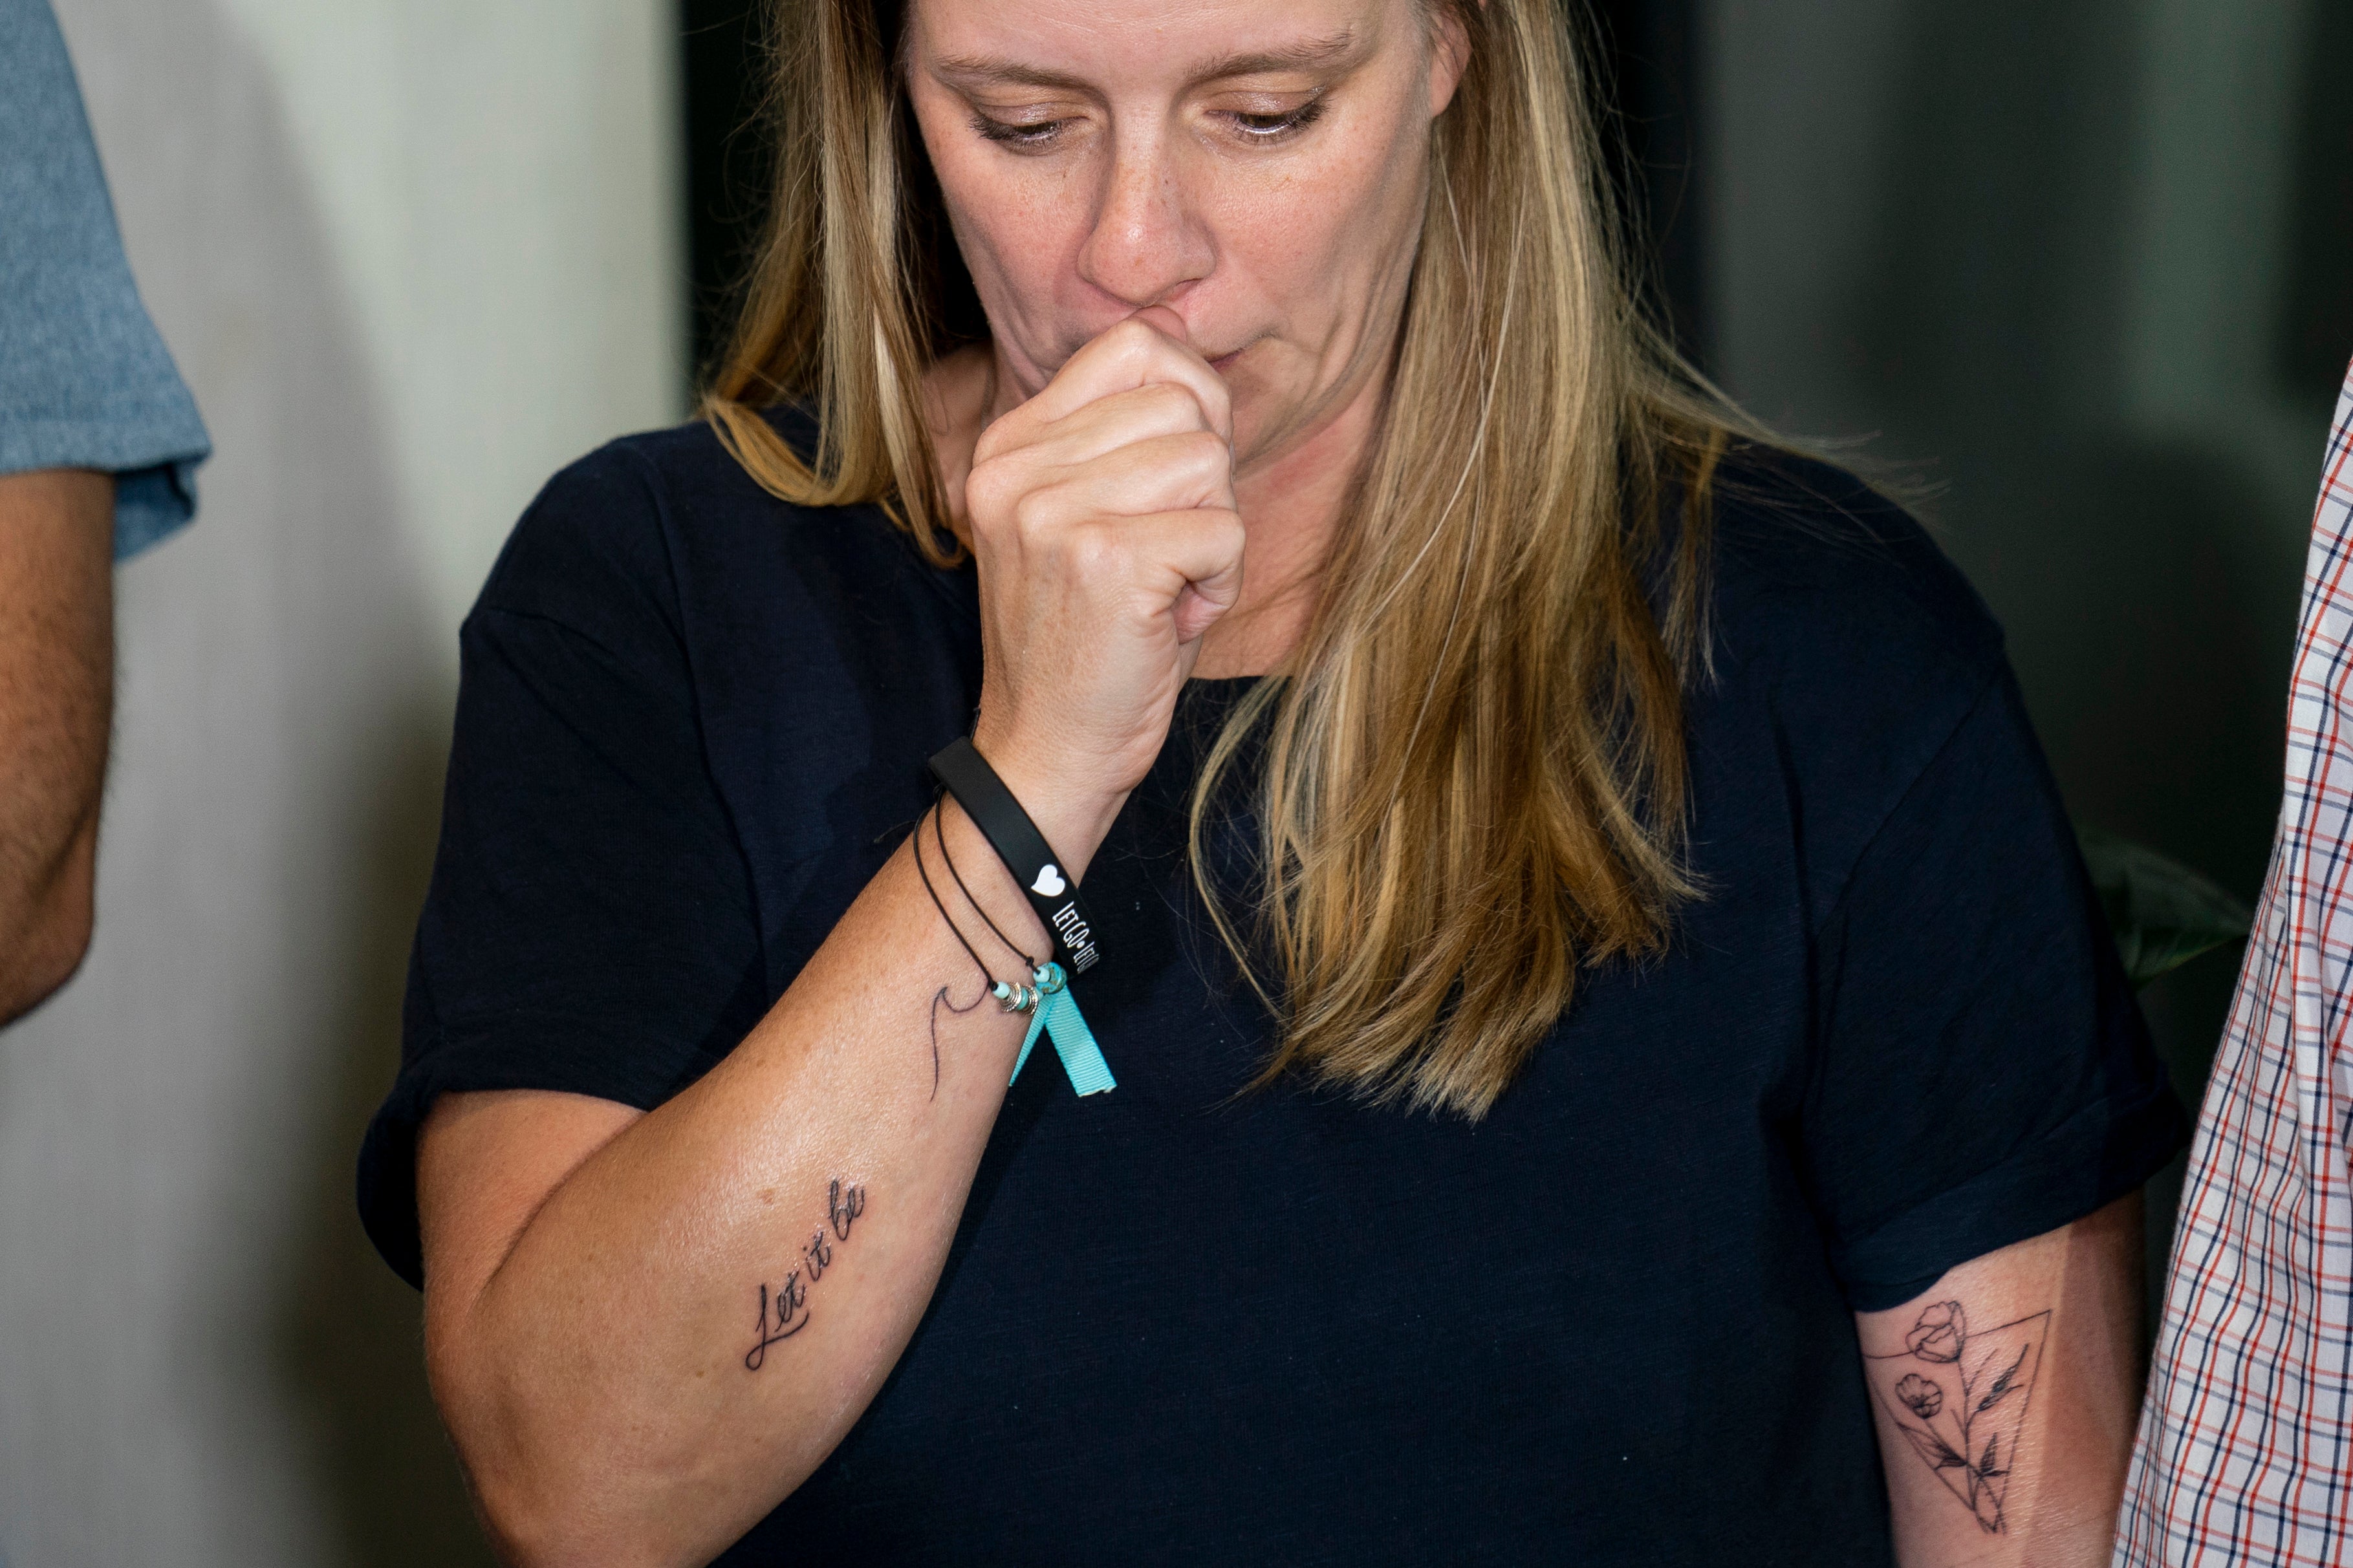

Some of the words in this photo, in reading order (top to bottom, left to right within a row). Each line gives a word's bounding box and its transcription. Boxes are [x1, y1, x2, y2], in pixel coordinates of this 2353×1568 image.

[1052, 901, 1079, 931] LET
[1063, 921, 1090, 949] GO
[745, 1269, 809, 1371] Let
[802, 1230, 831, 1282] it
[828, 1179, 865, 1241] be
